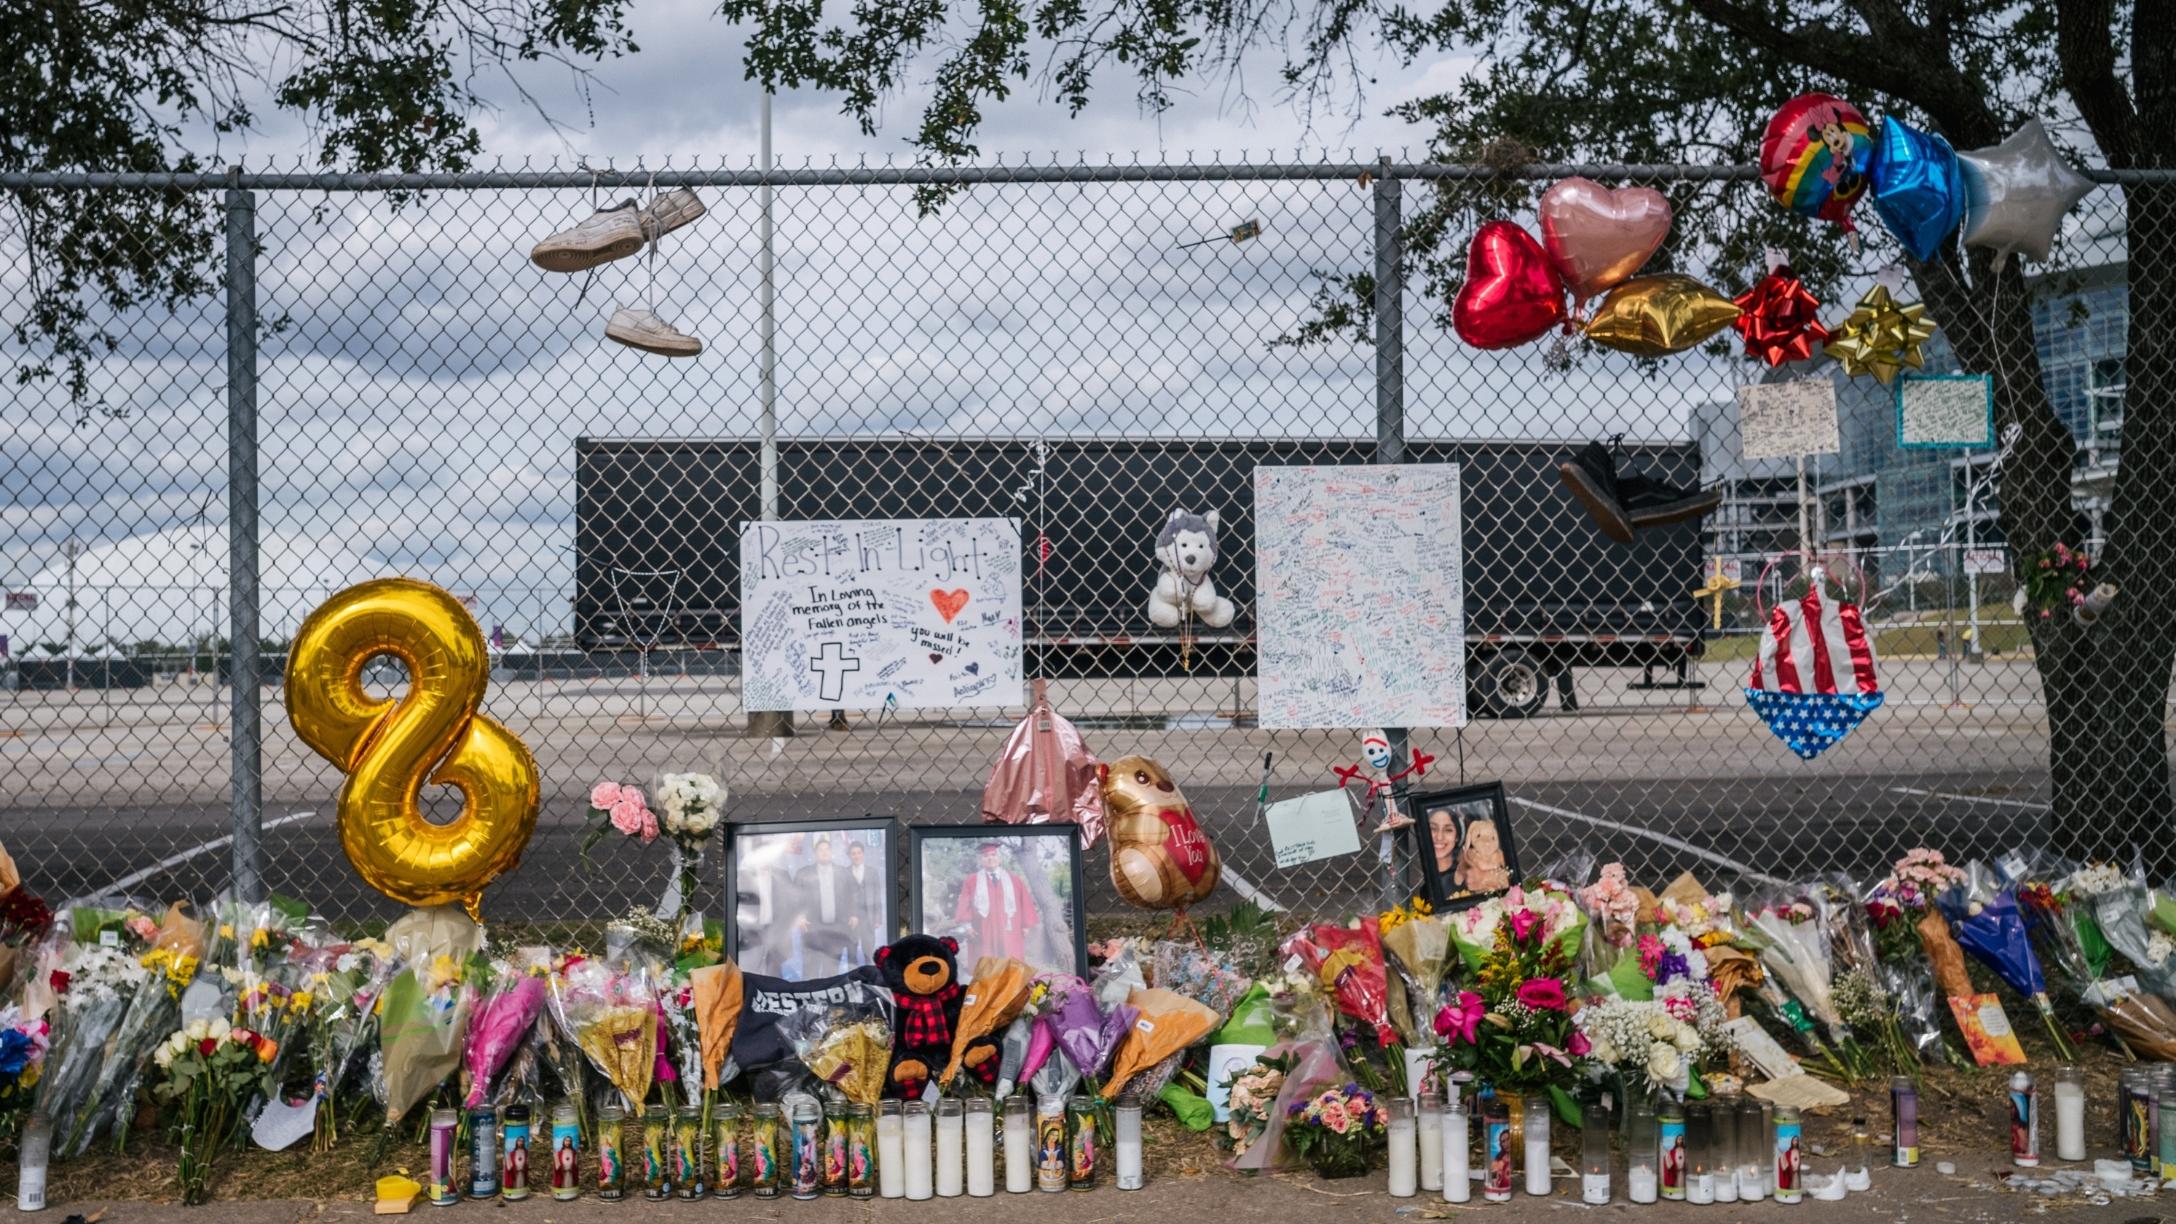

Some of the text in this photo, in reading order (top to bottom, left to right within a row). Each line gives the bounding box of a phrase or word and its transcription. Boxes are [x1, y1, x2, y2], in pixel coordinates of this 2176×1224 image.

[758, 525, 842, 580] Rest
[855, 532, 883, 573] In
[896, 527, 988, 582] Light
[808, 585, 877, 604] In Loving
[792, 600, 885, 617] memory of the
[808, 614, 888, 630] Fallen angels
[910, 626, 970, 648] you will be
[1170, 824, 1206, 847] I Love
[1184, 845, 1204, 866] You
